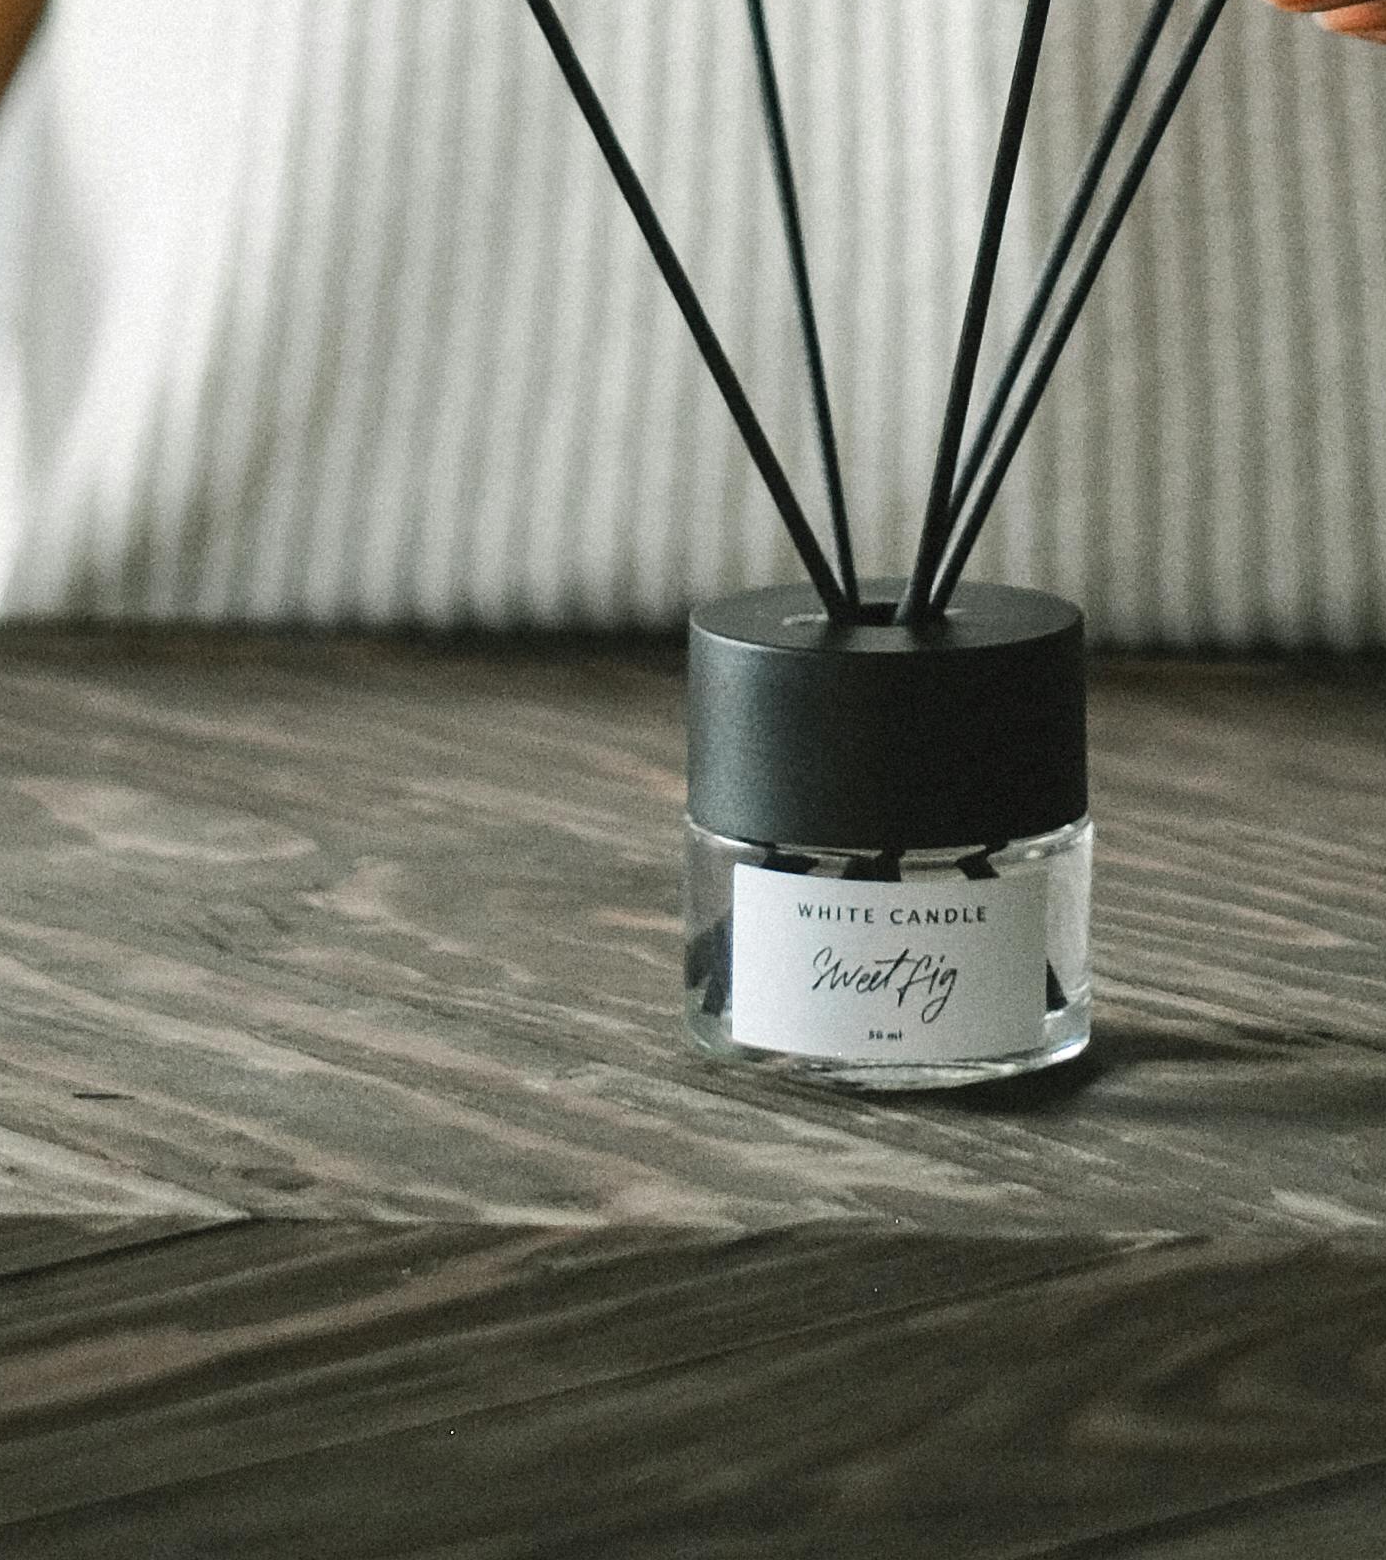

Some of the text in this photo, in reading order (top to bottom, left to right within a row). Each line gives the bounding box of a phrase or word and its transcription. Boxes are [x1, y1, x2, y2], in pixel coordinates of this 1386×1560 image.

[798, 903, 988, 925] WHITE CANDLE
[812, 946, 916, 994] Sweet
